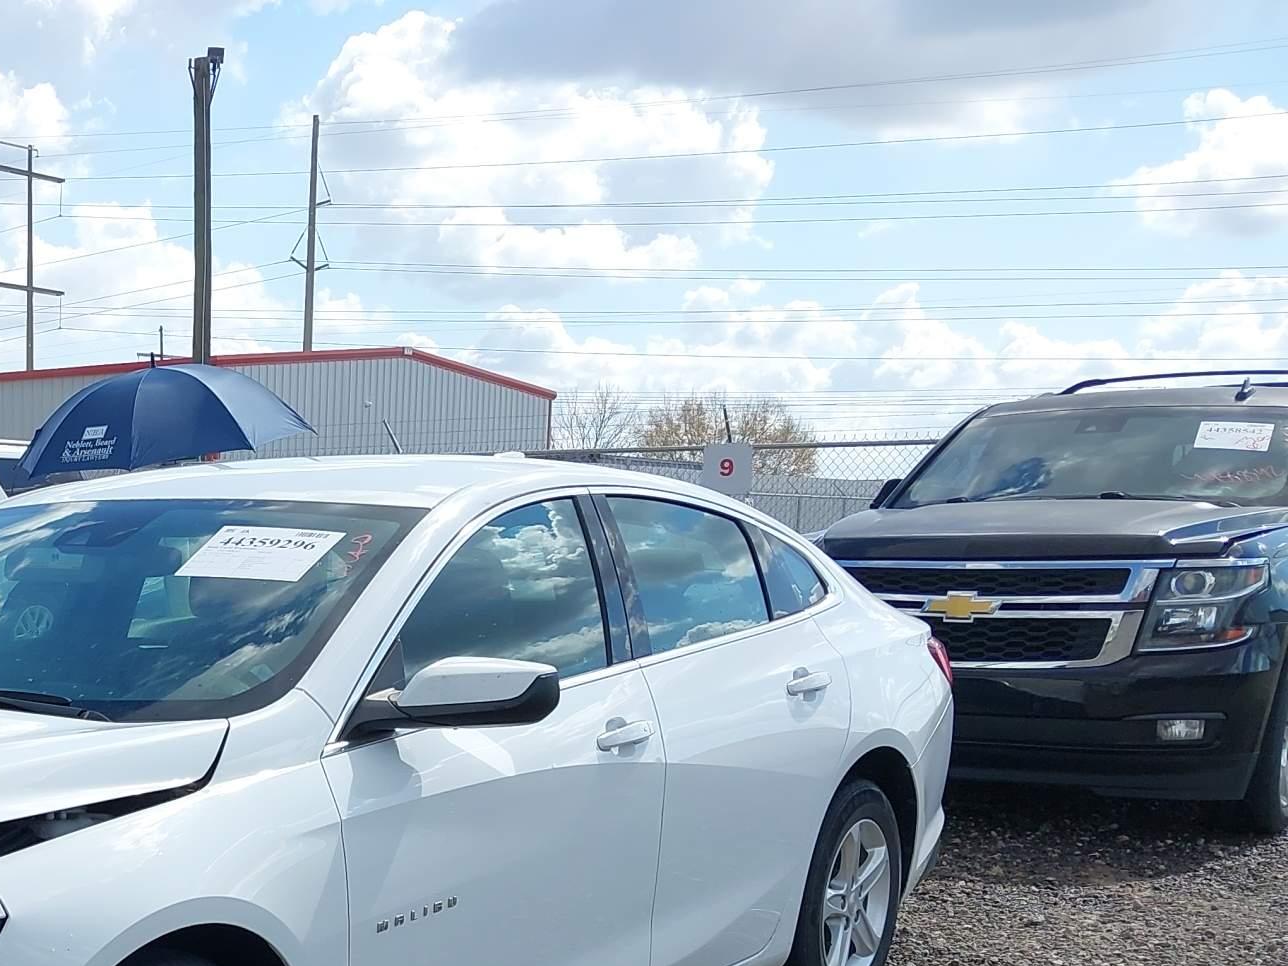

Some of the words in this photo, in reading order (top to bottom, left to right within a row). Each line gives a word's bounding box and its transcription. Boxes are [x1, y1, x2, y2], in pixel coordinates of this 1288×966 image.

[95, 436, 117, 447] Beard
[62, 448, 72, 457] &
[72, 445, 114, 456] Arsenault
[719, 458, 734, 477] 9
[220, 535, 316, 551] 44359296
[376, 895, 458, 934] MALIBU
